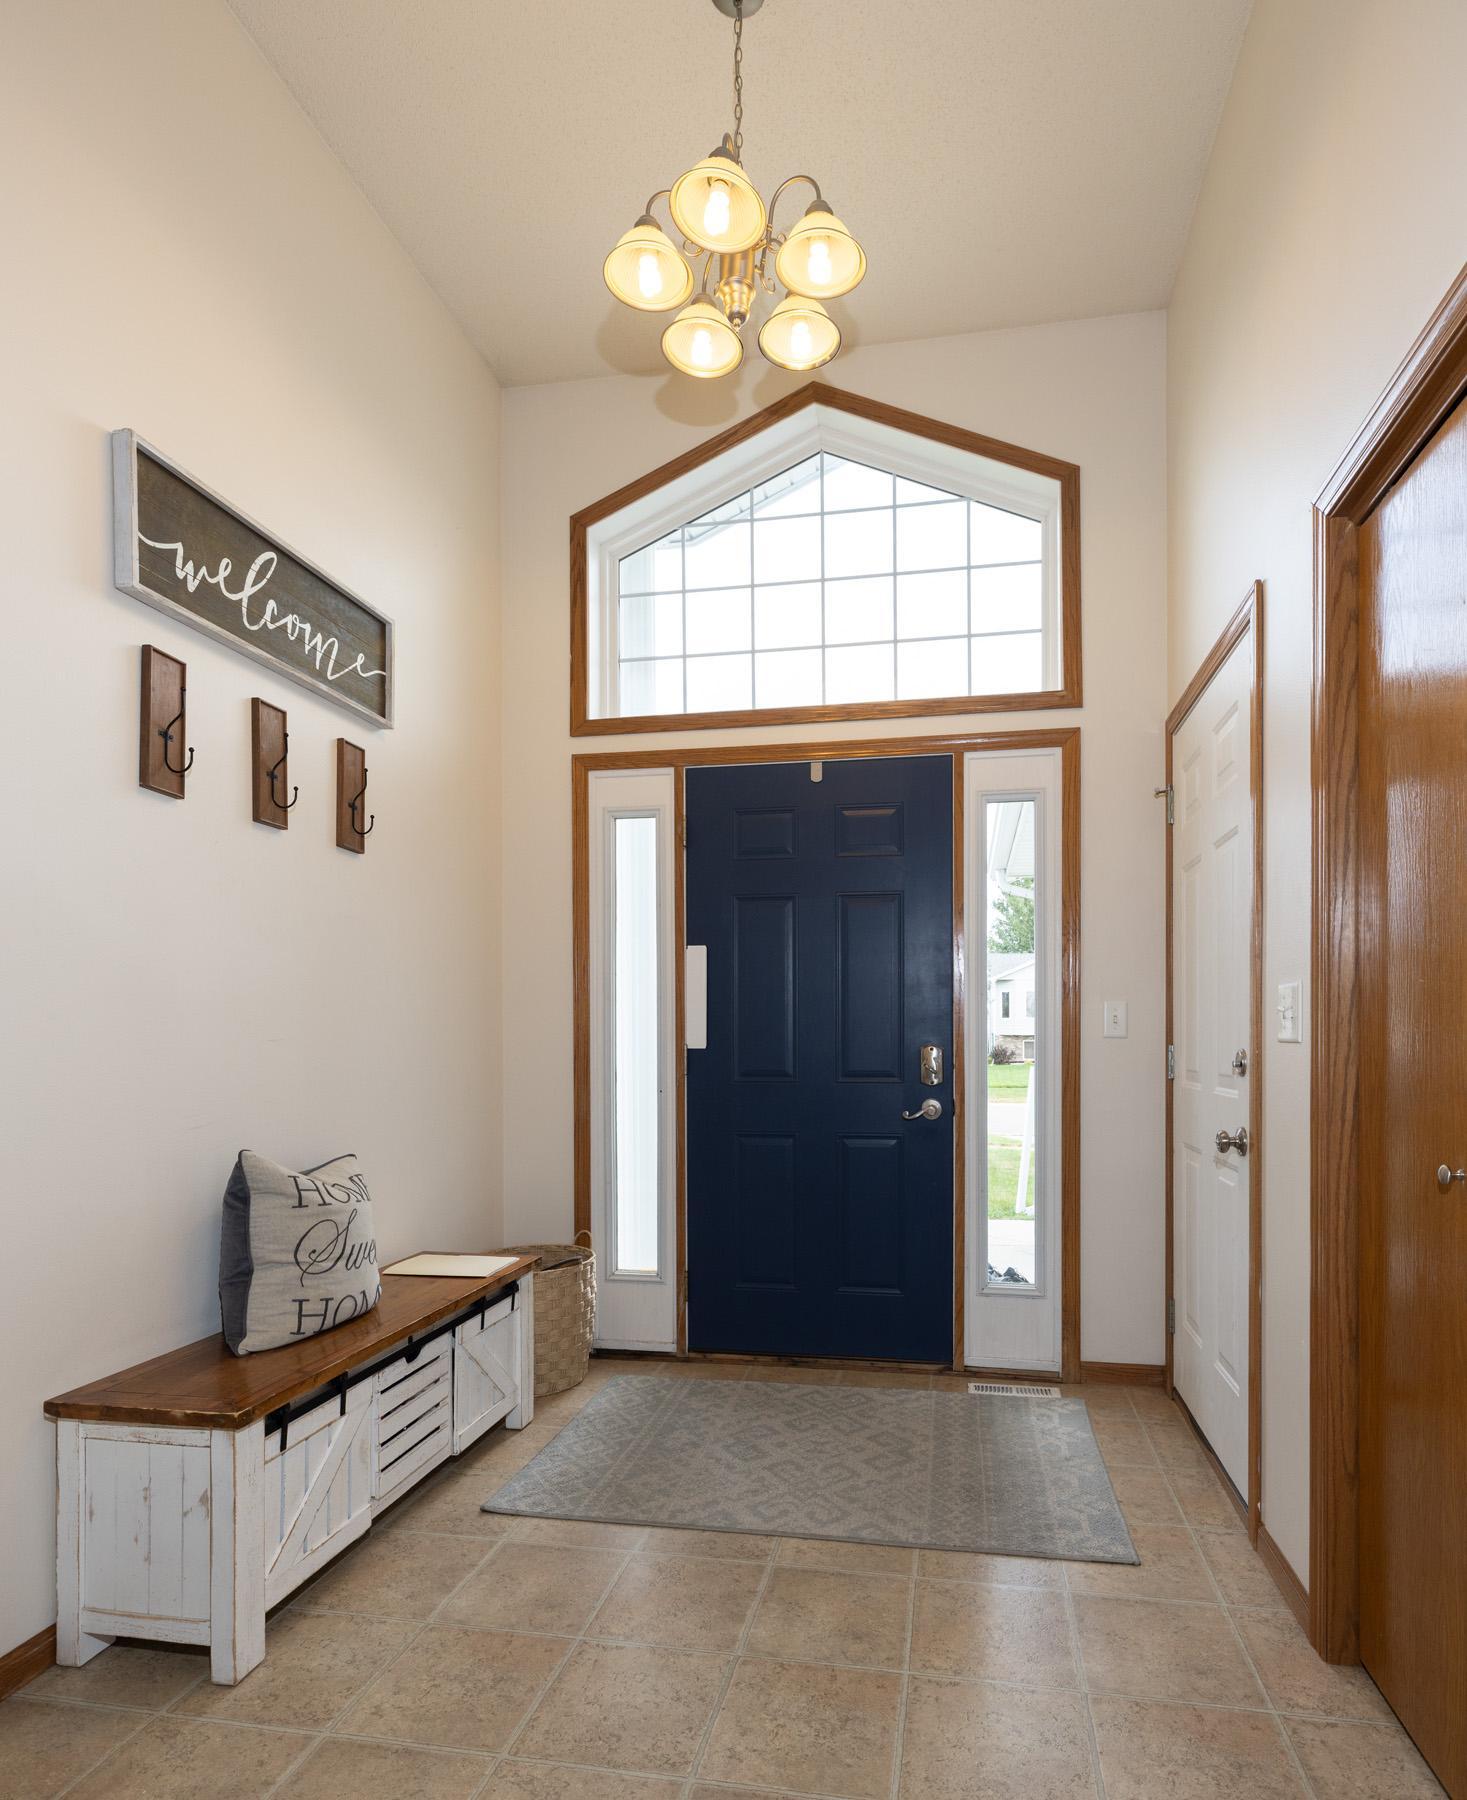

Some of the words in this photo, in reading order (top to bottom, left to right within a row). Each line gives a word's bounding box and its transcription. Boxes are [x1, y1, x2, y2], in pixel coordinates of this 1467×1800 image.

[137, 530, 386, 681] welcome
[287, 1174, 370, 1208] HOM
[294, 1208, 377, 1287] Swe
[290, 1284, 381, 1336] HOM
